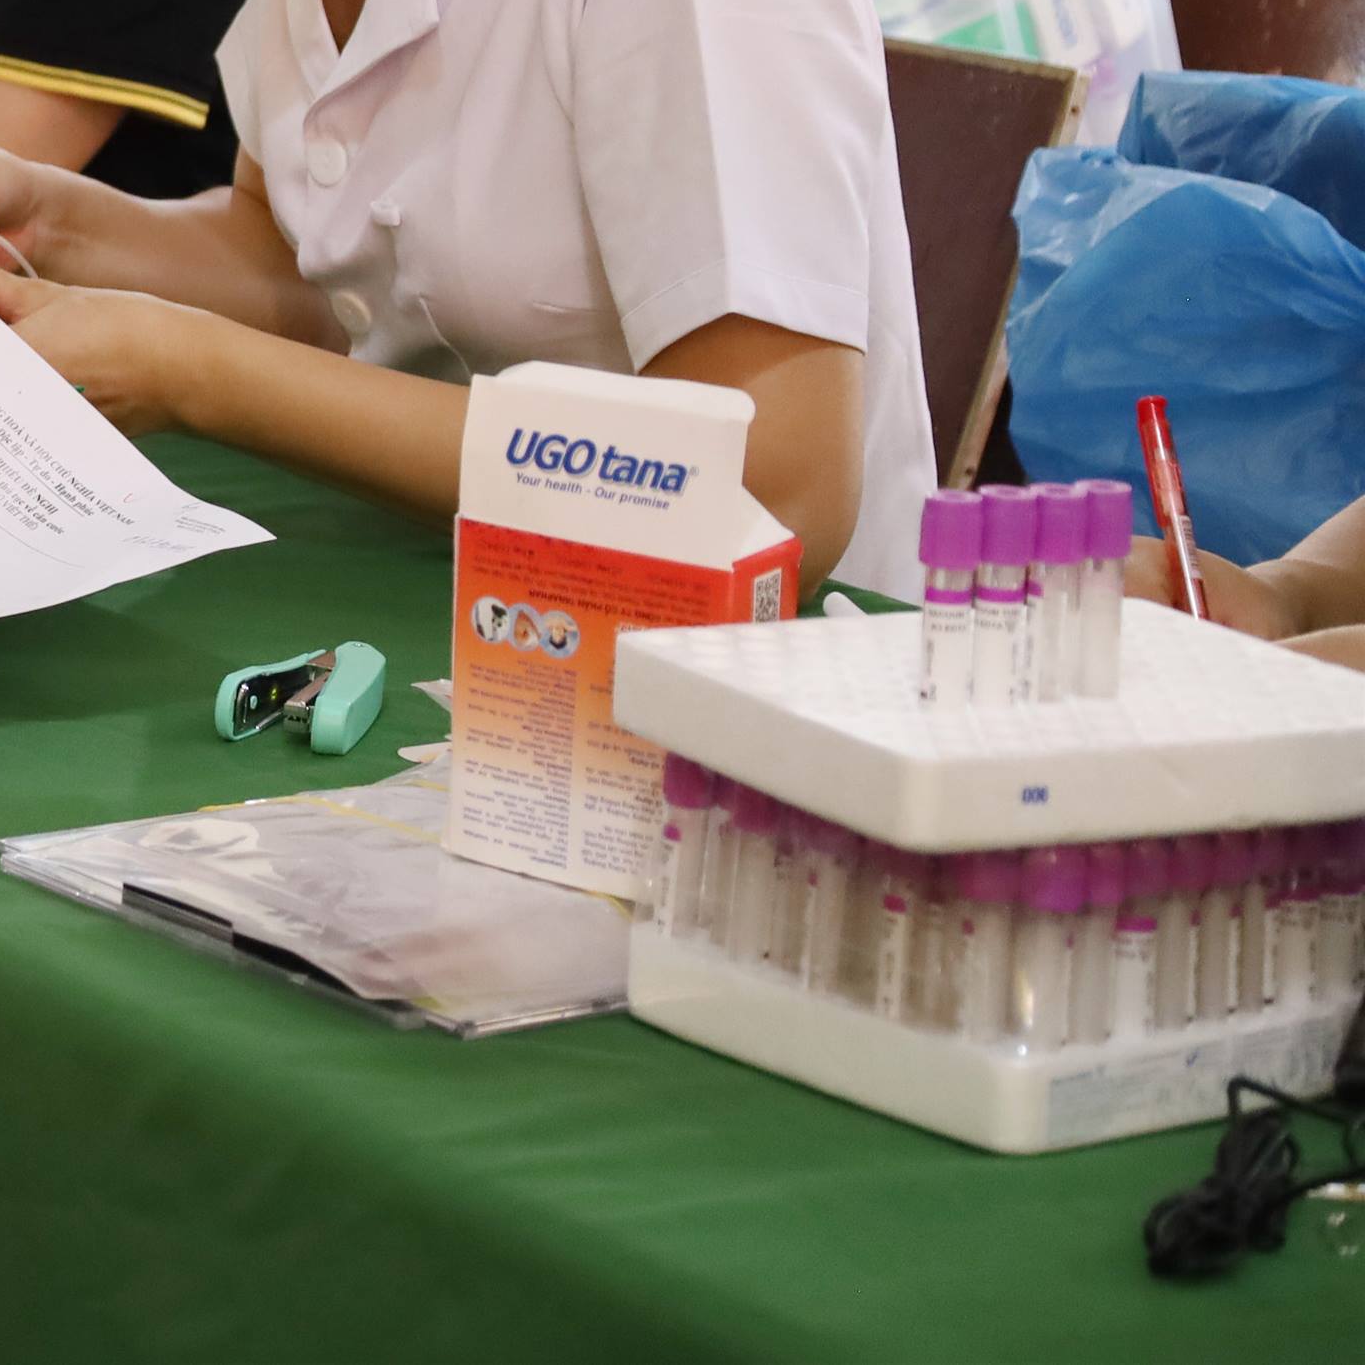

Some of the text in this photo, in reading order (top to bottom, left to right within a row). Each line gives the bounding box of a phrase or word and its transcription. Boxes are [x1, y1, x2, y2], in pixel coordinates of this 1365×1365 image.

[516, 472, 542, 490] Your
[544, 477, 582, 496] health
[595, 487, 617, 503] Our
[619, 493, 670, 511] promise
